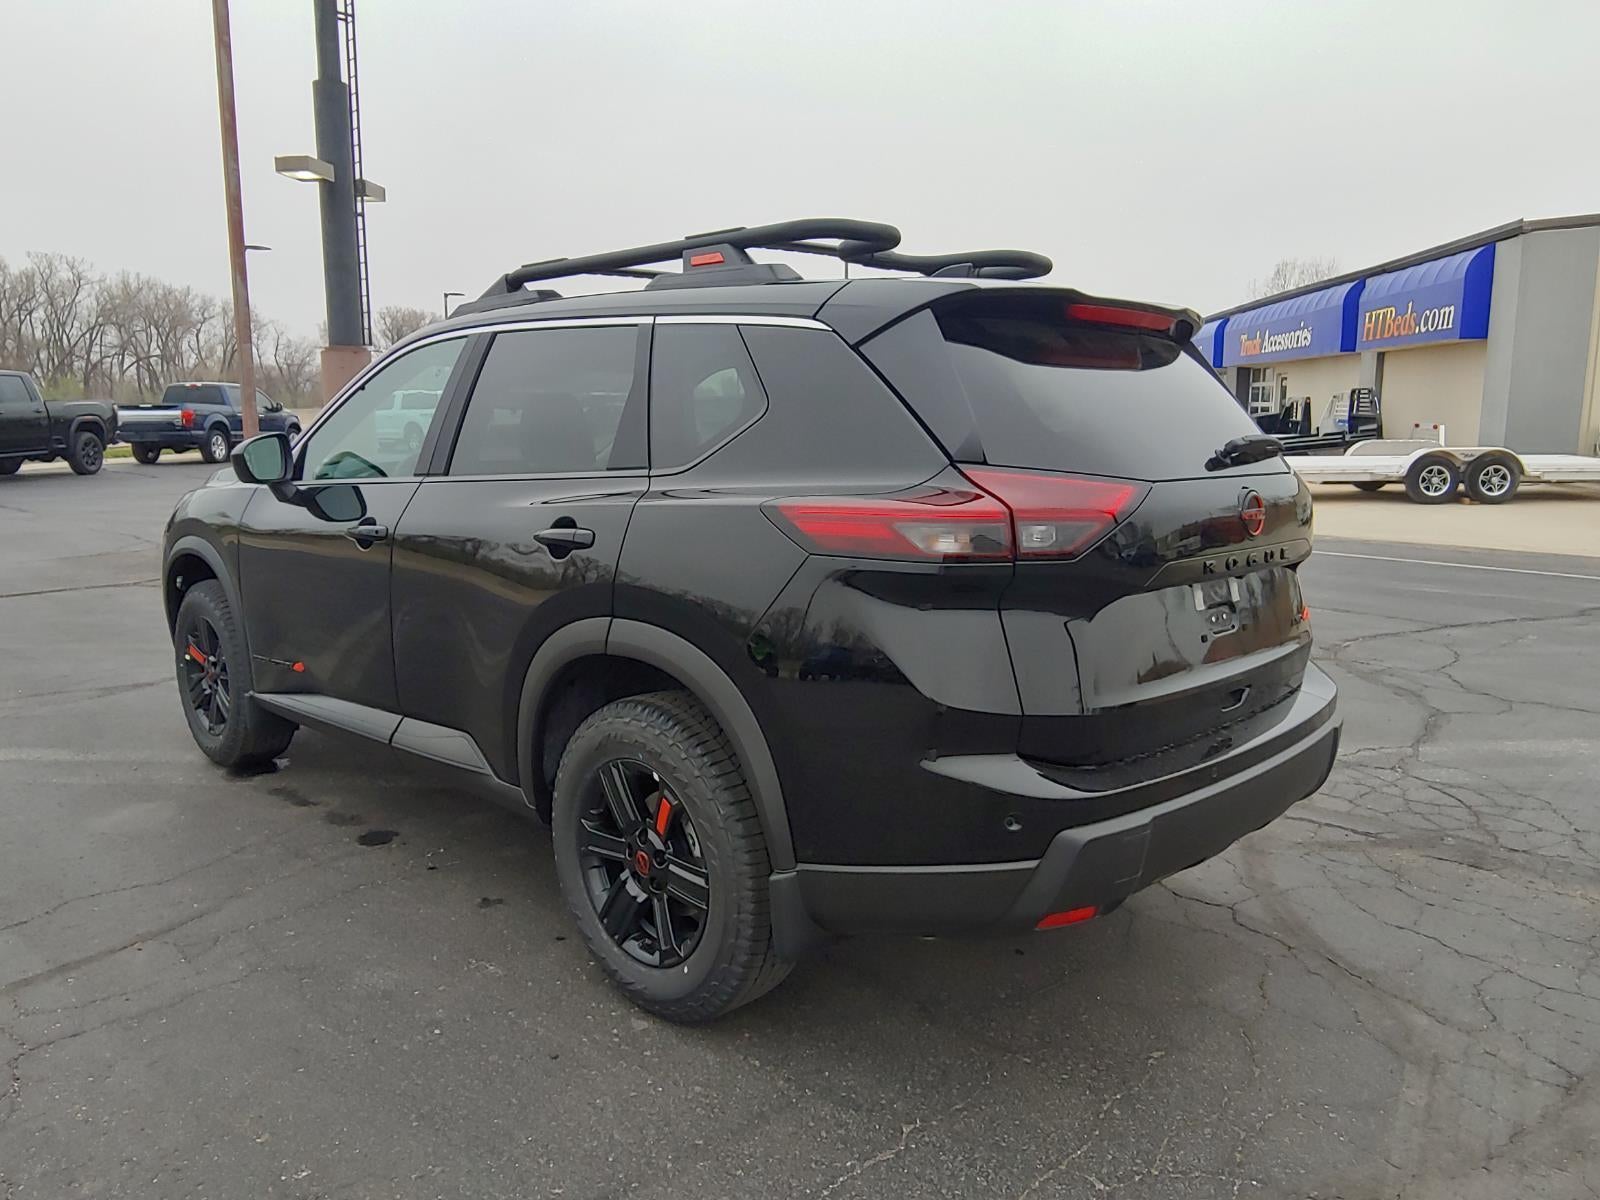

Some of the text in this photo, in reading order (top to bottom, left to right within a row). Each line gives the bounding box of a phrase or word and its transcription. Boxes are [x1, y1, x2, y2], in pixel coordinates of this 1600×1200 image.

[1240, 320, 1312, 356] Truck Accessories
[1362, 300, 1455, 341] HTBeds.com
